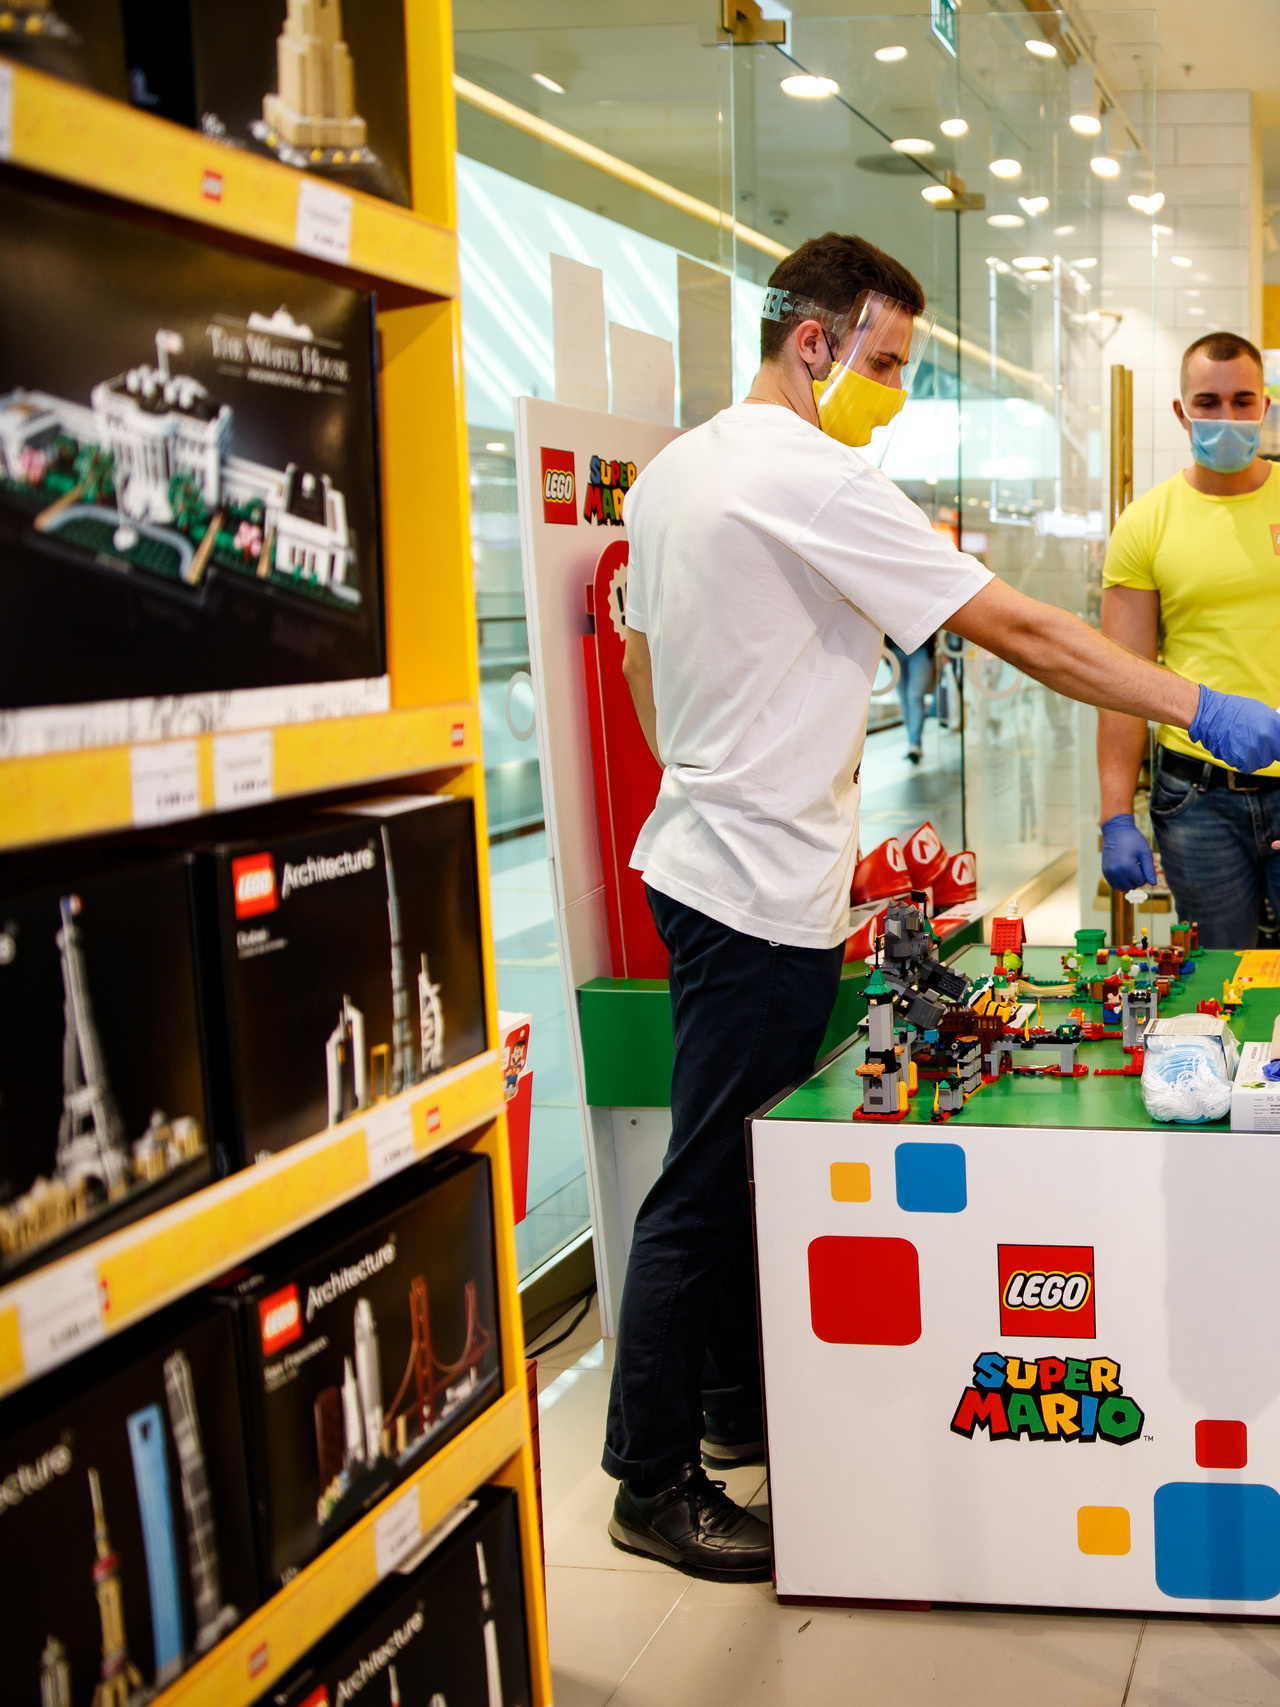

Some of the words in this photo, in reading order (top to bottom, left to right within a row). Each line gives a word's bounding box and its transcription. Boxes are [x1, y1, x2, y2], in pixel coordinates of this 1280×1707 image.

[544, 470, 574, 502] LEGO
[590, 455, 637, 488] SUPER
[583, 482, 626, 525] MAR
[282, 847, 376, 900] Architecture
[306, 1242, 396, 1323] Architecture
[1005, 1272, 1090, 1310] LEGO
[974, 1352, 1123, 1394] SUPER
[951, 1387, 1145, 1446] MARIO
